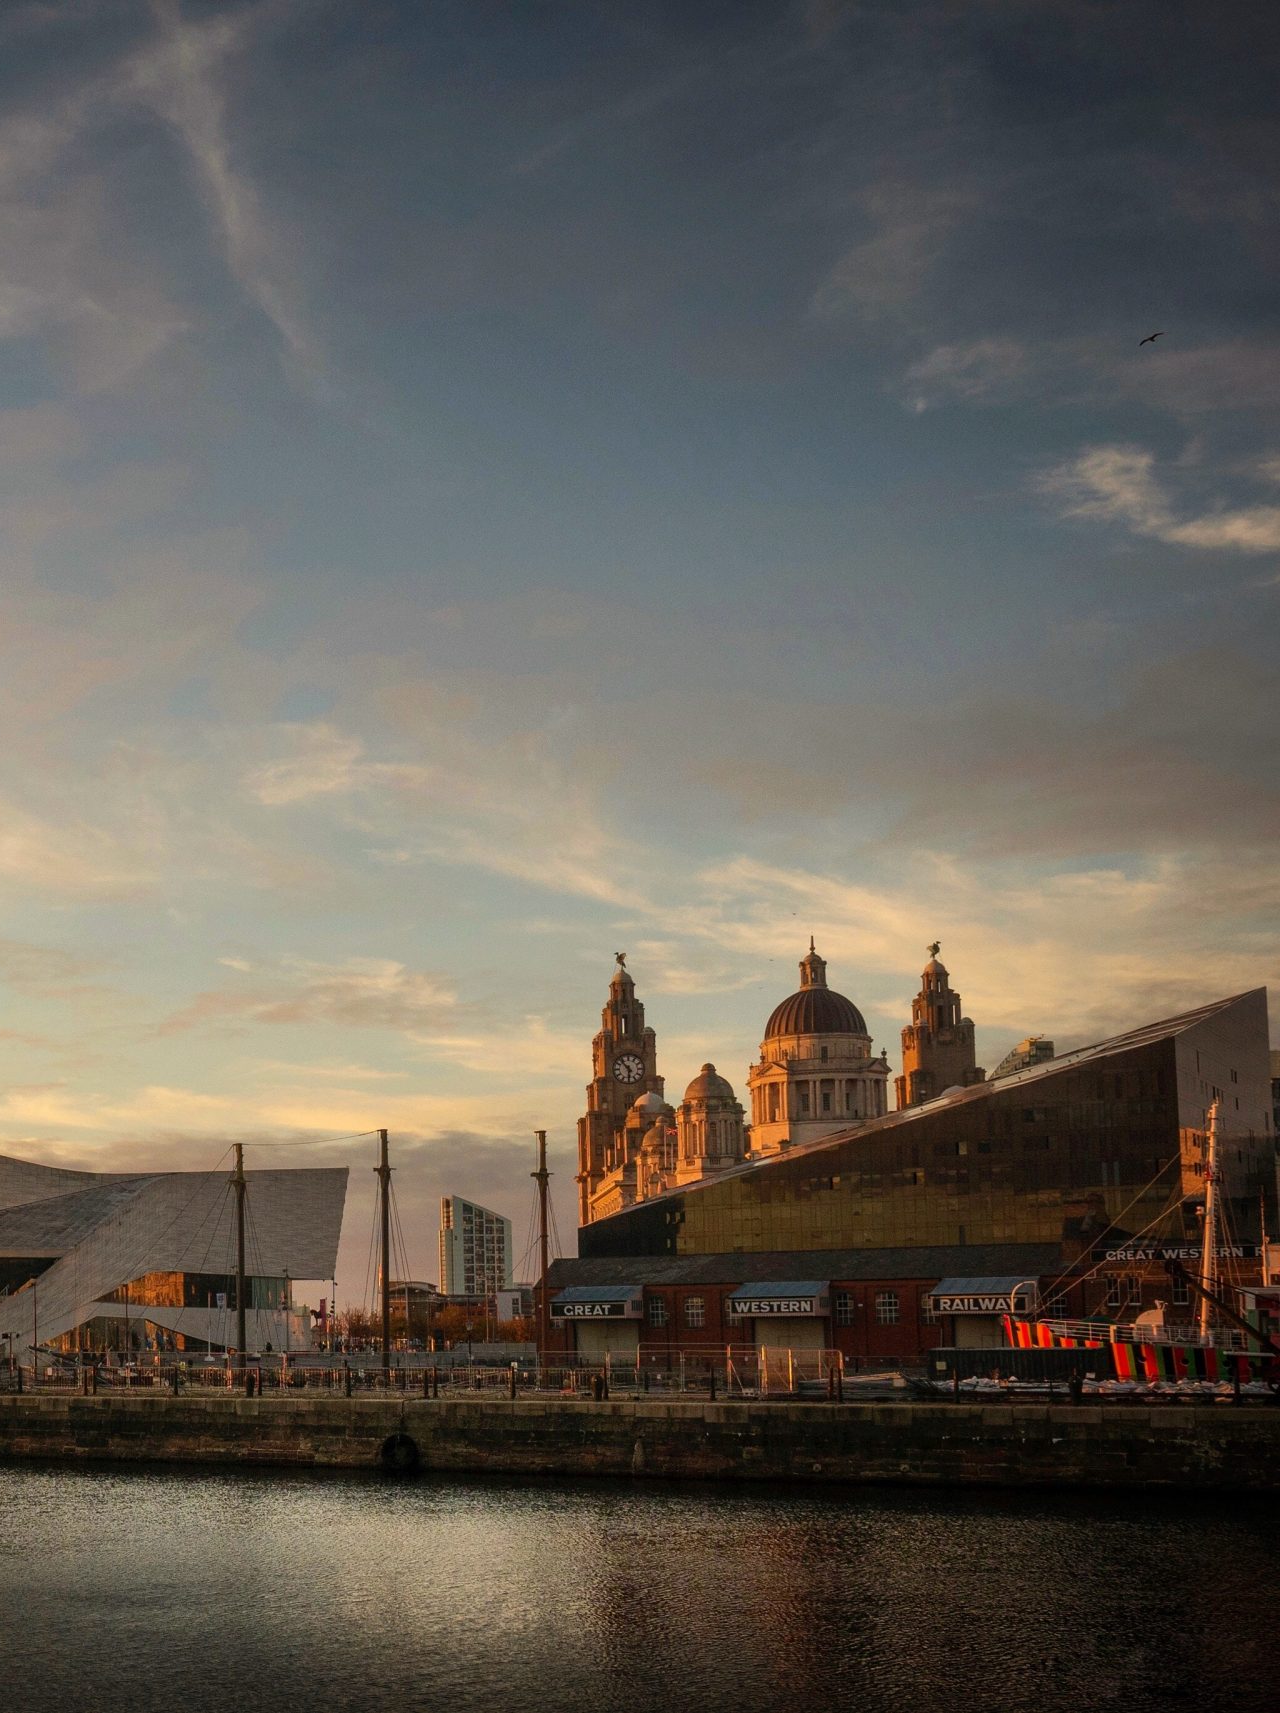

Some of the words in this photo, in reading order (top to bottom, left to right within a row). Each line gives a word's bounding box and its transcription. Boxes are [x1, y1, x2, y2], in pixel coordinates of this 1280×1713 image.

[1105, 1249, 1155, 1261] GREAT
[563, 1304, 611, 1316] GREAT
[735, 1300, 811, 1313] WESTERN
[939, 1297, 1018, 1311] RAILWAY
